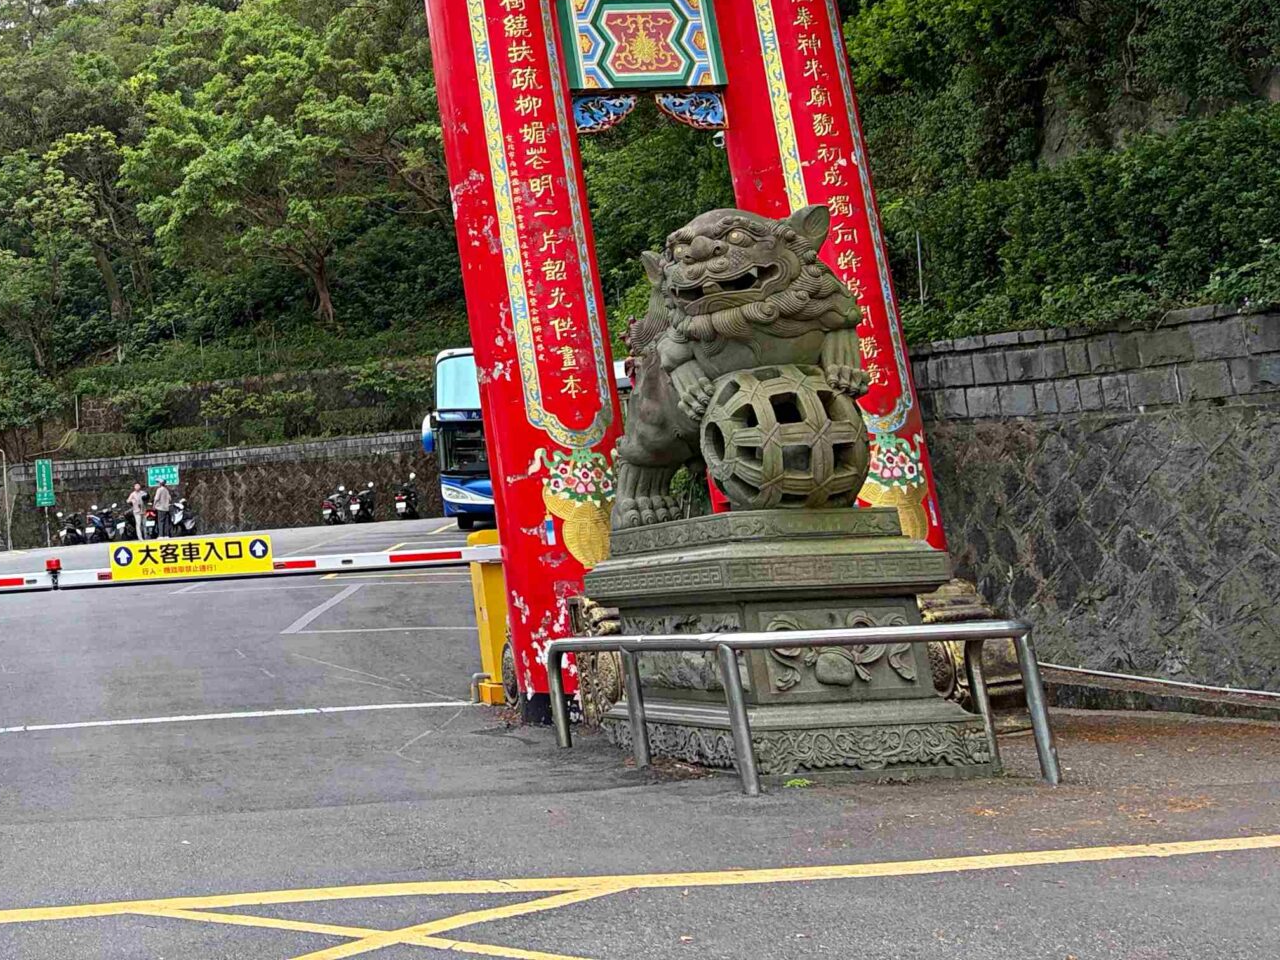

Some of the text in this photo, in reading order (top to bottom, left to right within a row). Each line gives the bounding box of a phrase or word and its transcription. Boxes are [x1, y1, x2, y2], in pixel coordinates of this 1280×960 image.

[138, 541, 243, 565] 大客車入口
